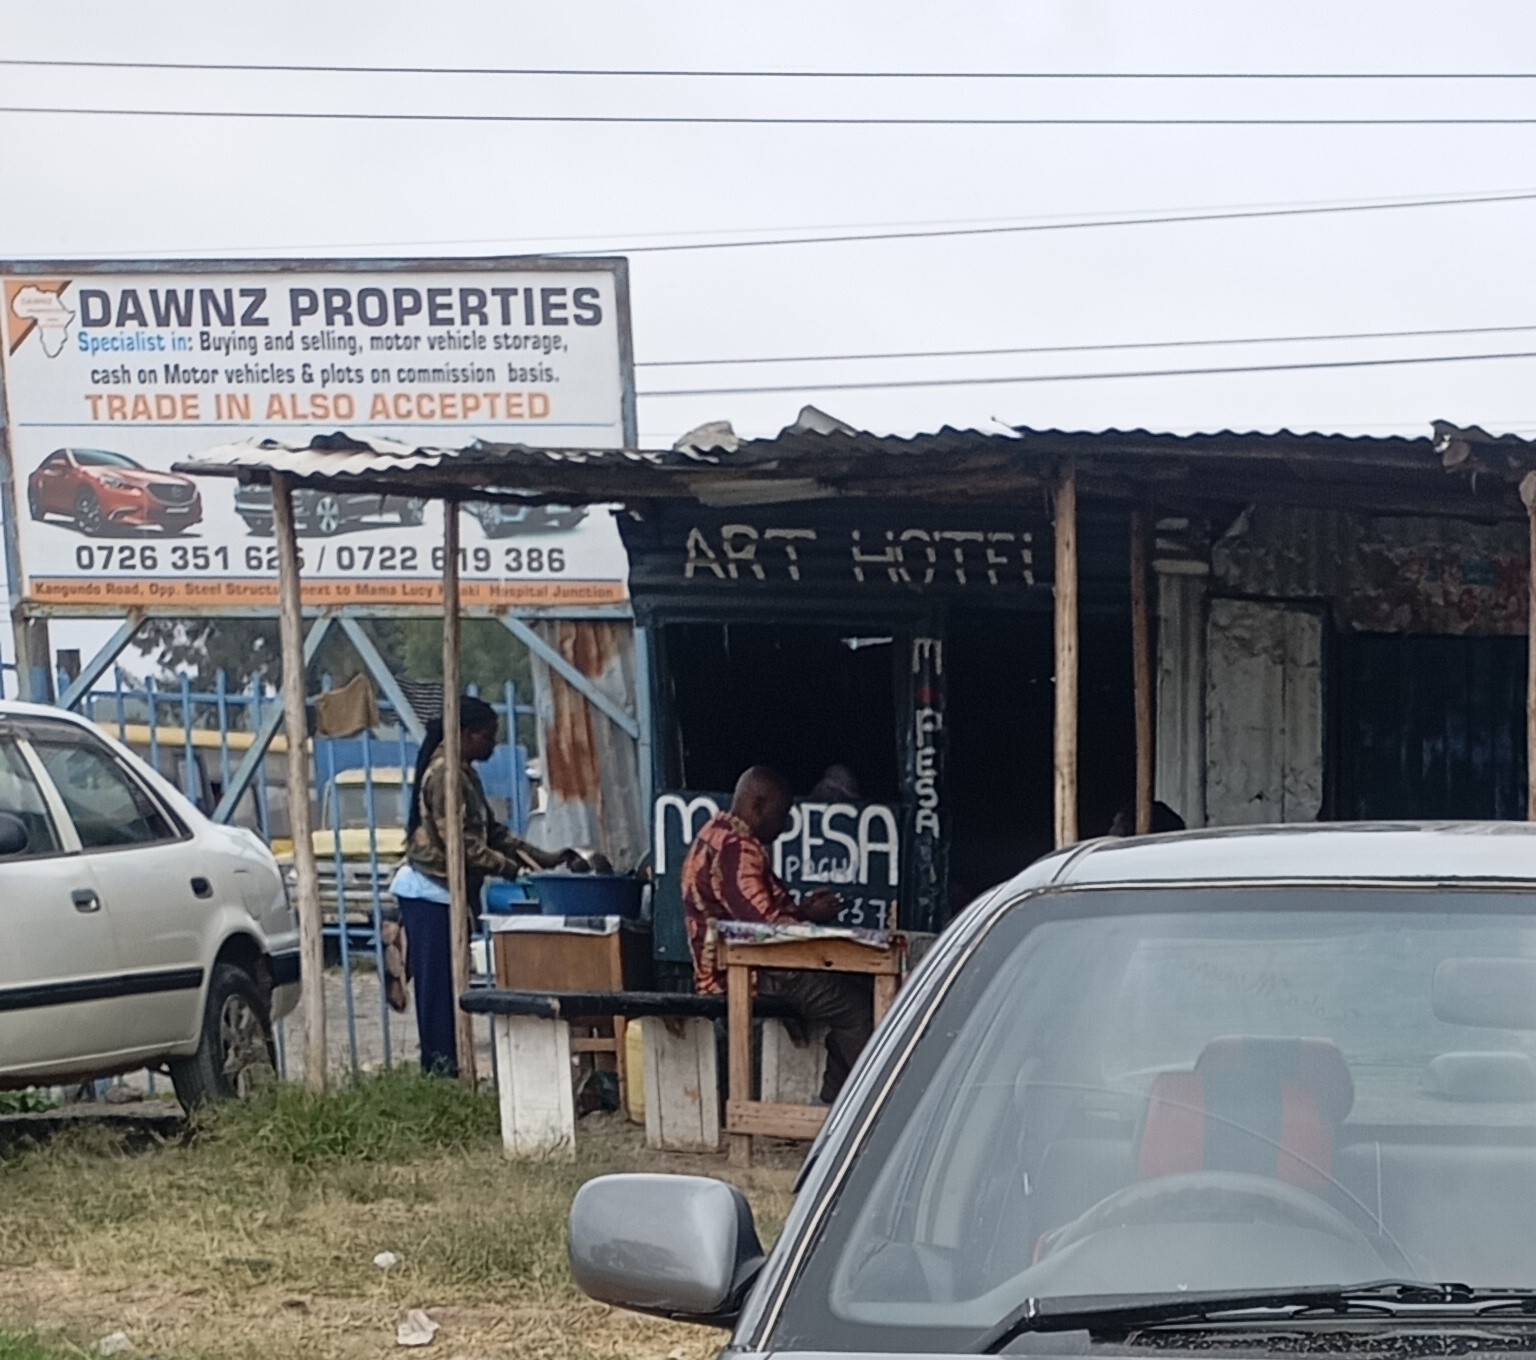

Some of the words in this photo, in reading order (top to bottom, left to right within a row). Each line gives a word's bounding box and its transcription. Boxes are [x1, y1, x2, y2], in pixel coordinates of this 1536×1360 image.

[78, 287, 270, 328] DAWNZ
[288, 286, 603, 328] PROPERTIES
[77, 330, 166, 356] Specialist
[171, 331, 194, 351] in:
[199, 330, 258, 356] Buying
[264, 330, 295, 352] and
[301, 330, 363, 356] selling,
[370, 332, 421, 351] motor
[427, 330, 487, 351] vehicle
[493, 332, 568, 356] storage,
[91, 363, 131, 385] cash
[137, 367, 158, 385] on
[164, 363, 219, 385] Motor
[224, 362, 295, 385] vehicles
[301, 362, 314, 384] &
[321, 362, 364, 388] plots
[371, 366, 391, 384] on
[397, 362, 496, 384] commission
[508, 361, 560, 384] basis.
[85, 393, 201, 421] TRADE
[214, 393, 250, 421] IN
[265, 392, 355, 421] ALSO
[369, 392, 552, 421] ACCEPTED
[75, 545, 158, 571] 0726
[171, 545, 230, 571] 351
[336, 546, 418, 571] 0722
[505, 547, 566, 573] 386
[683, 523, 818, 581] ART
[35, 582, 102, 598] Kangundo
[185, 582, 222, 595] Steel
[336, 585, 350, 597] to
[402, 585, 433, 600] Lucy
[553, 586, 614, 599] Junction
